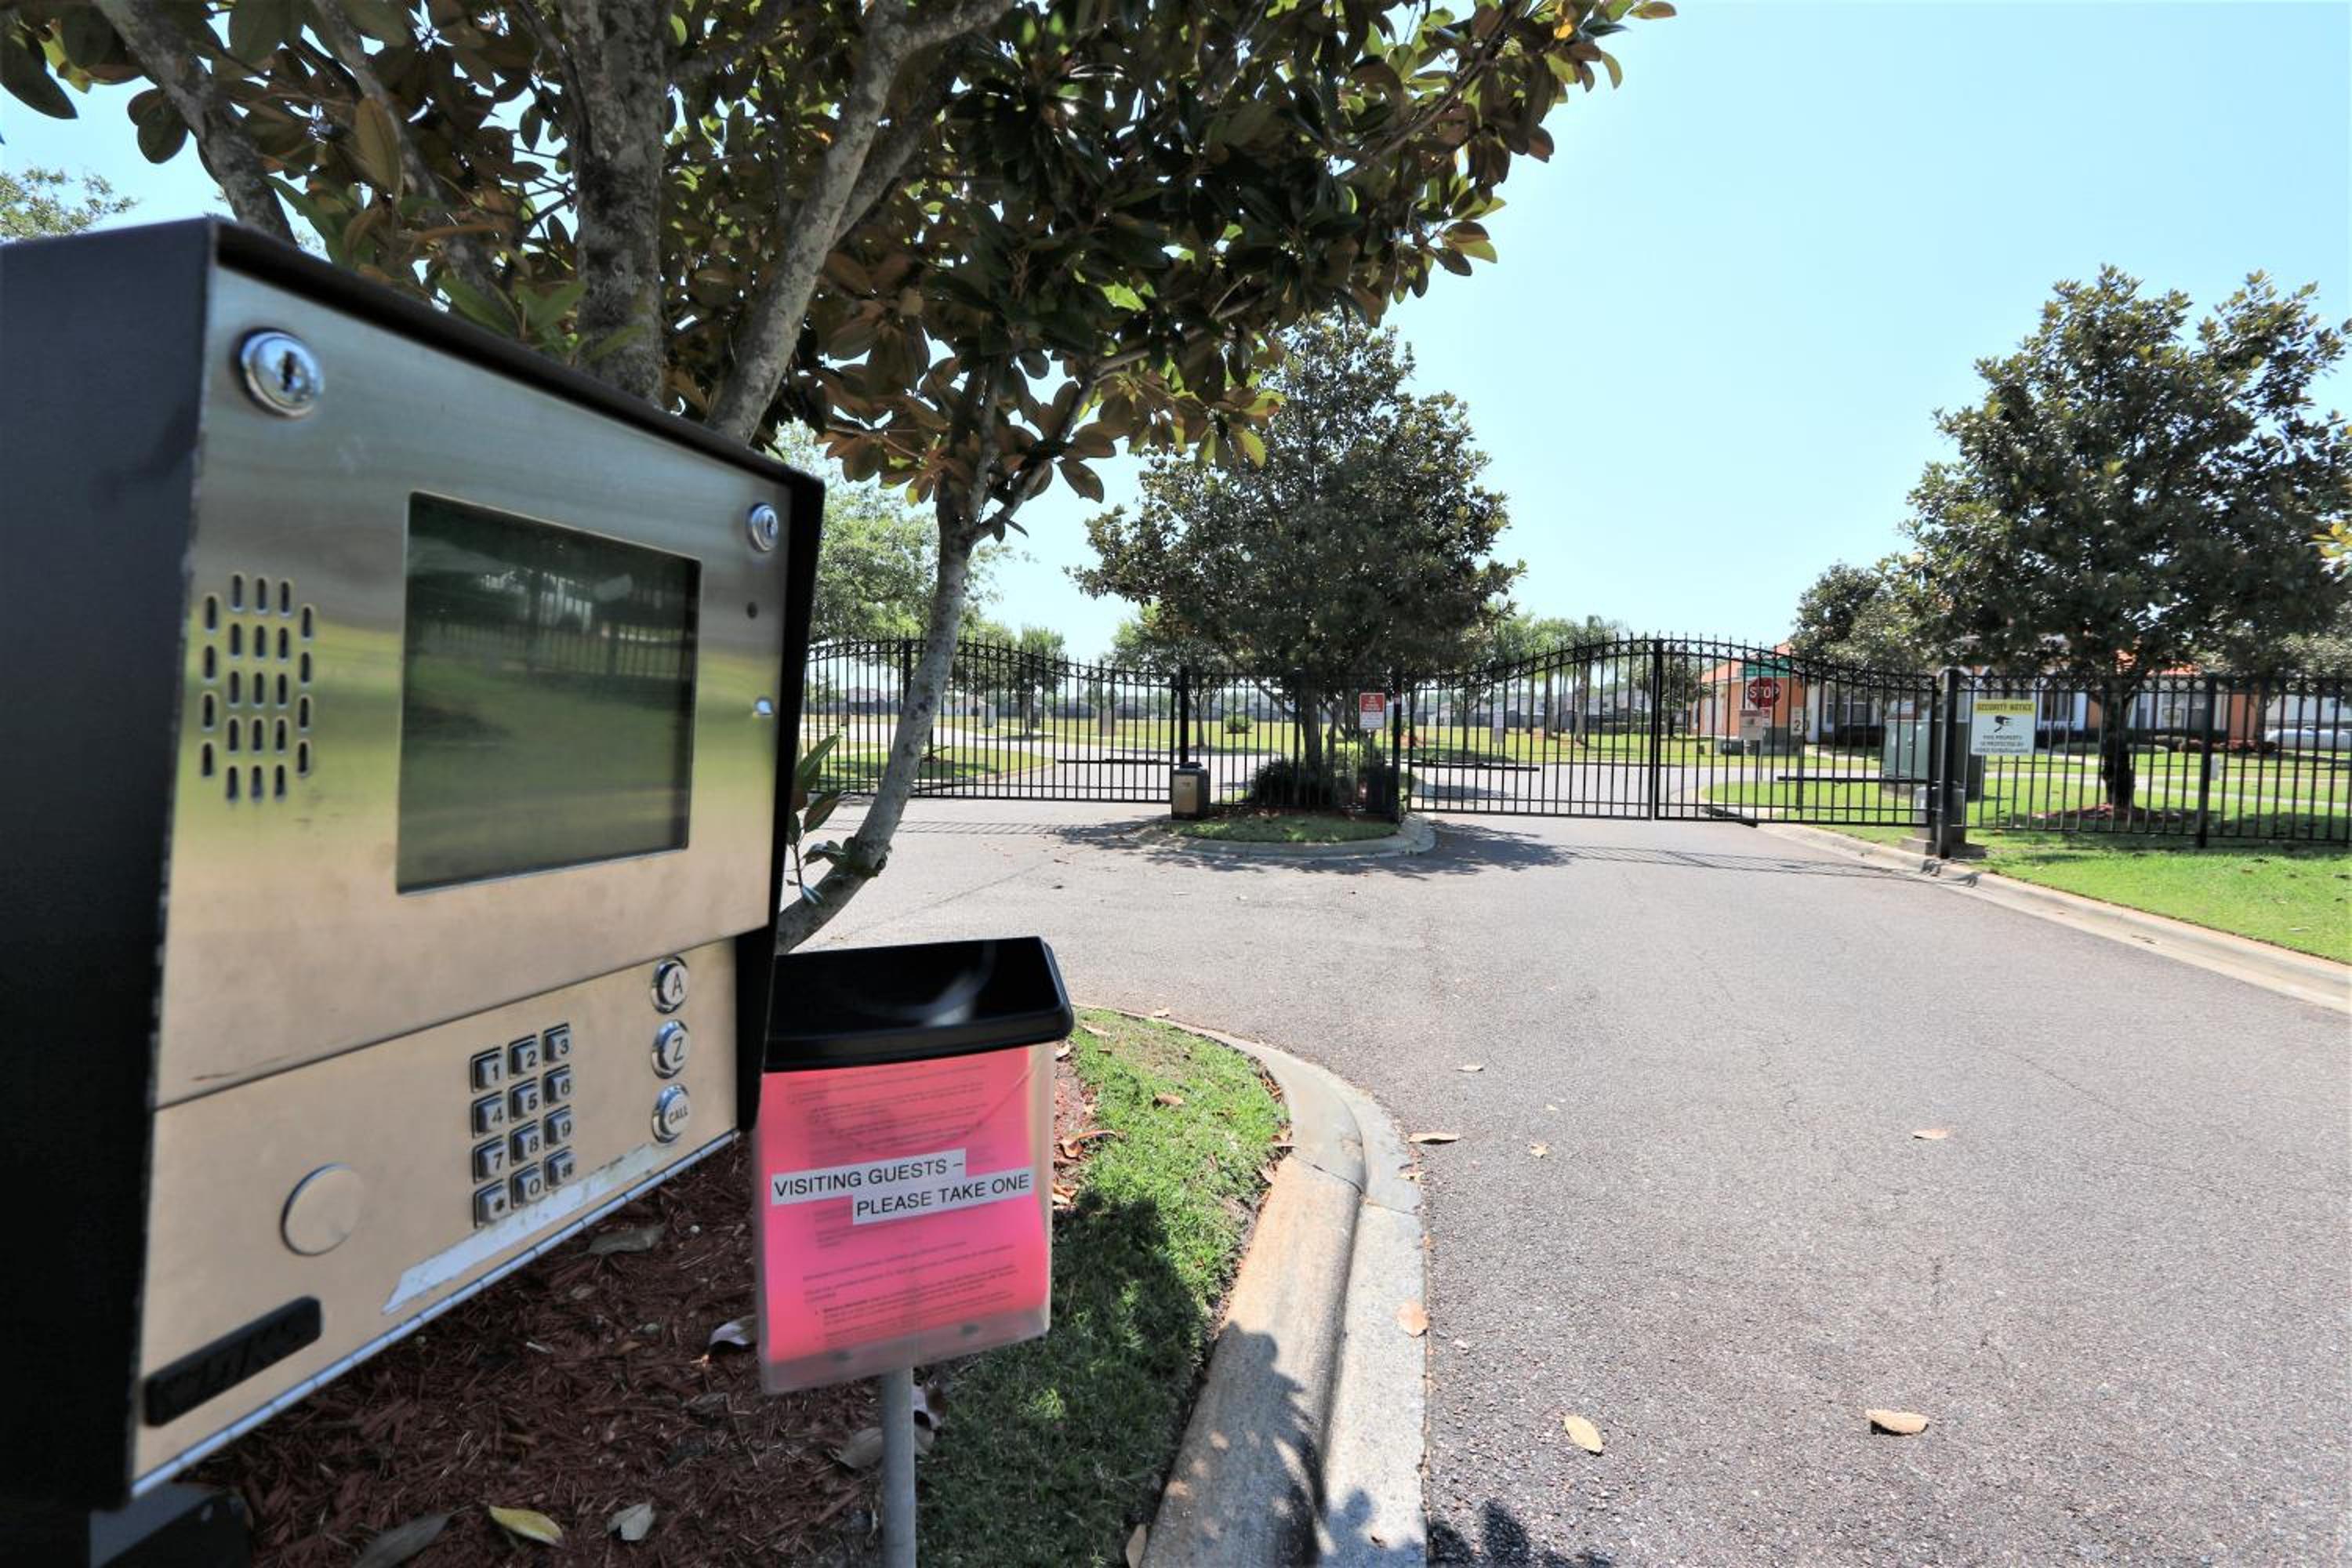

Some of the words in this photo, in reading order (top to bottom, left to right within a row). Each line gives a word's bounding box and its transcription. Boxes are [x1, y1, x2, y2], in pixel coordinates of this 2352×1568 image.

[671, 971, 684, 997] A
[492, 1063, 499, 1080] 1
[527, 1051, 537, 1068] 2
[560, 1038, 569, 1054] 3
[673, 1036, 684, 1063] Z
[492, 1107, 503, 1123] 4
[528, 1092, 537, 1110] 5
[561, 1078, 571, 1095] 6
[668, 1105, 689, 1125] CALL
[493, 1152, 503, 1171] 7
[528, 1136, 539, 1152] 8
[561, 1120, 572, 1137] 9
[774, 1171, 862, 1197] VISITING
[868, 1159, 947, 1185] GUESTS
[856, 1192, 932, 1217] PLEASE
[940, 1181, 985, 1203] TAKE
[992, 1174, 1029, 1195] ONE
